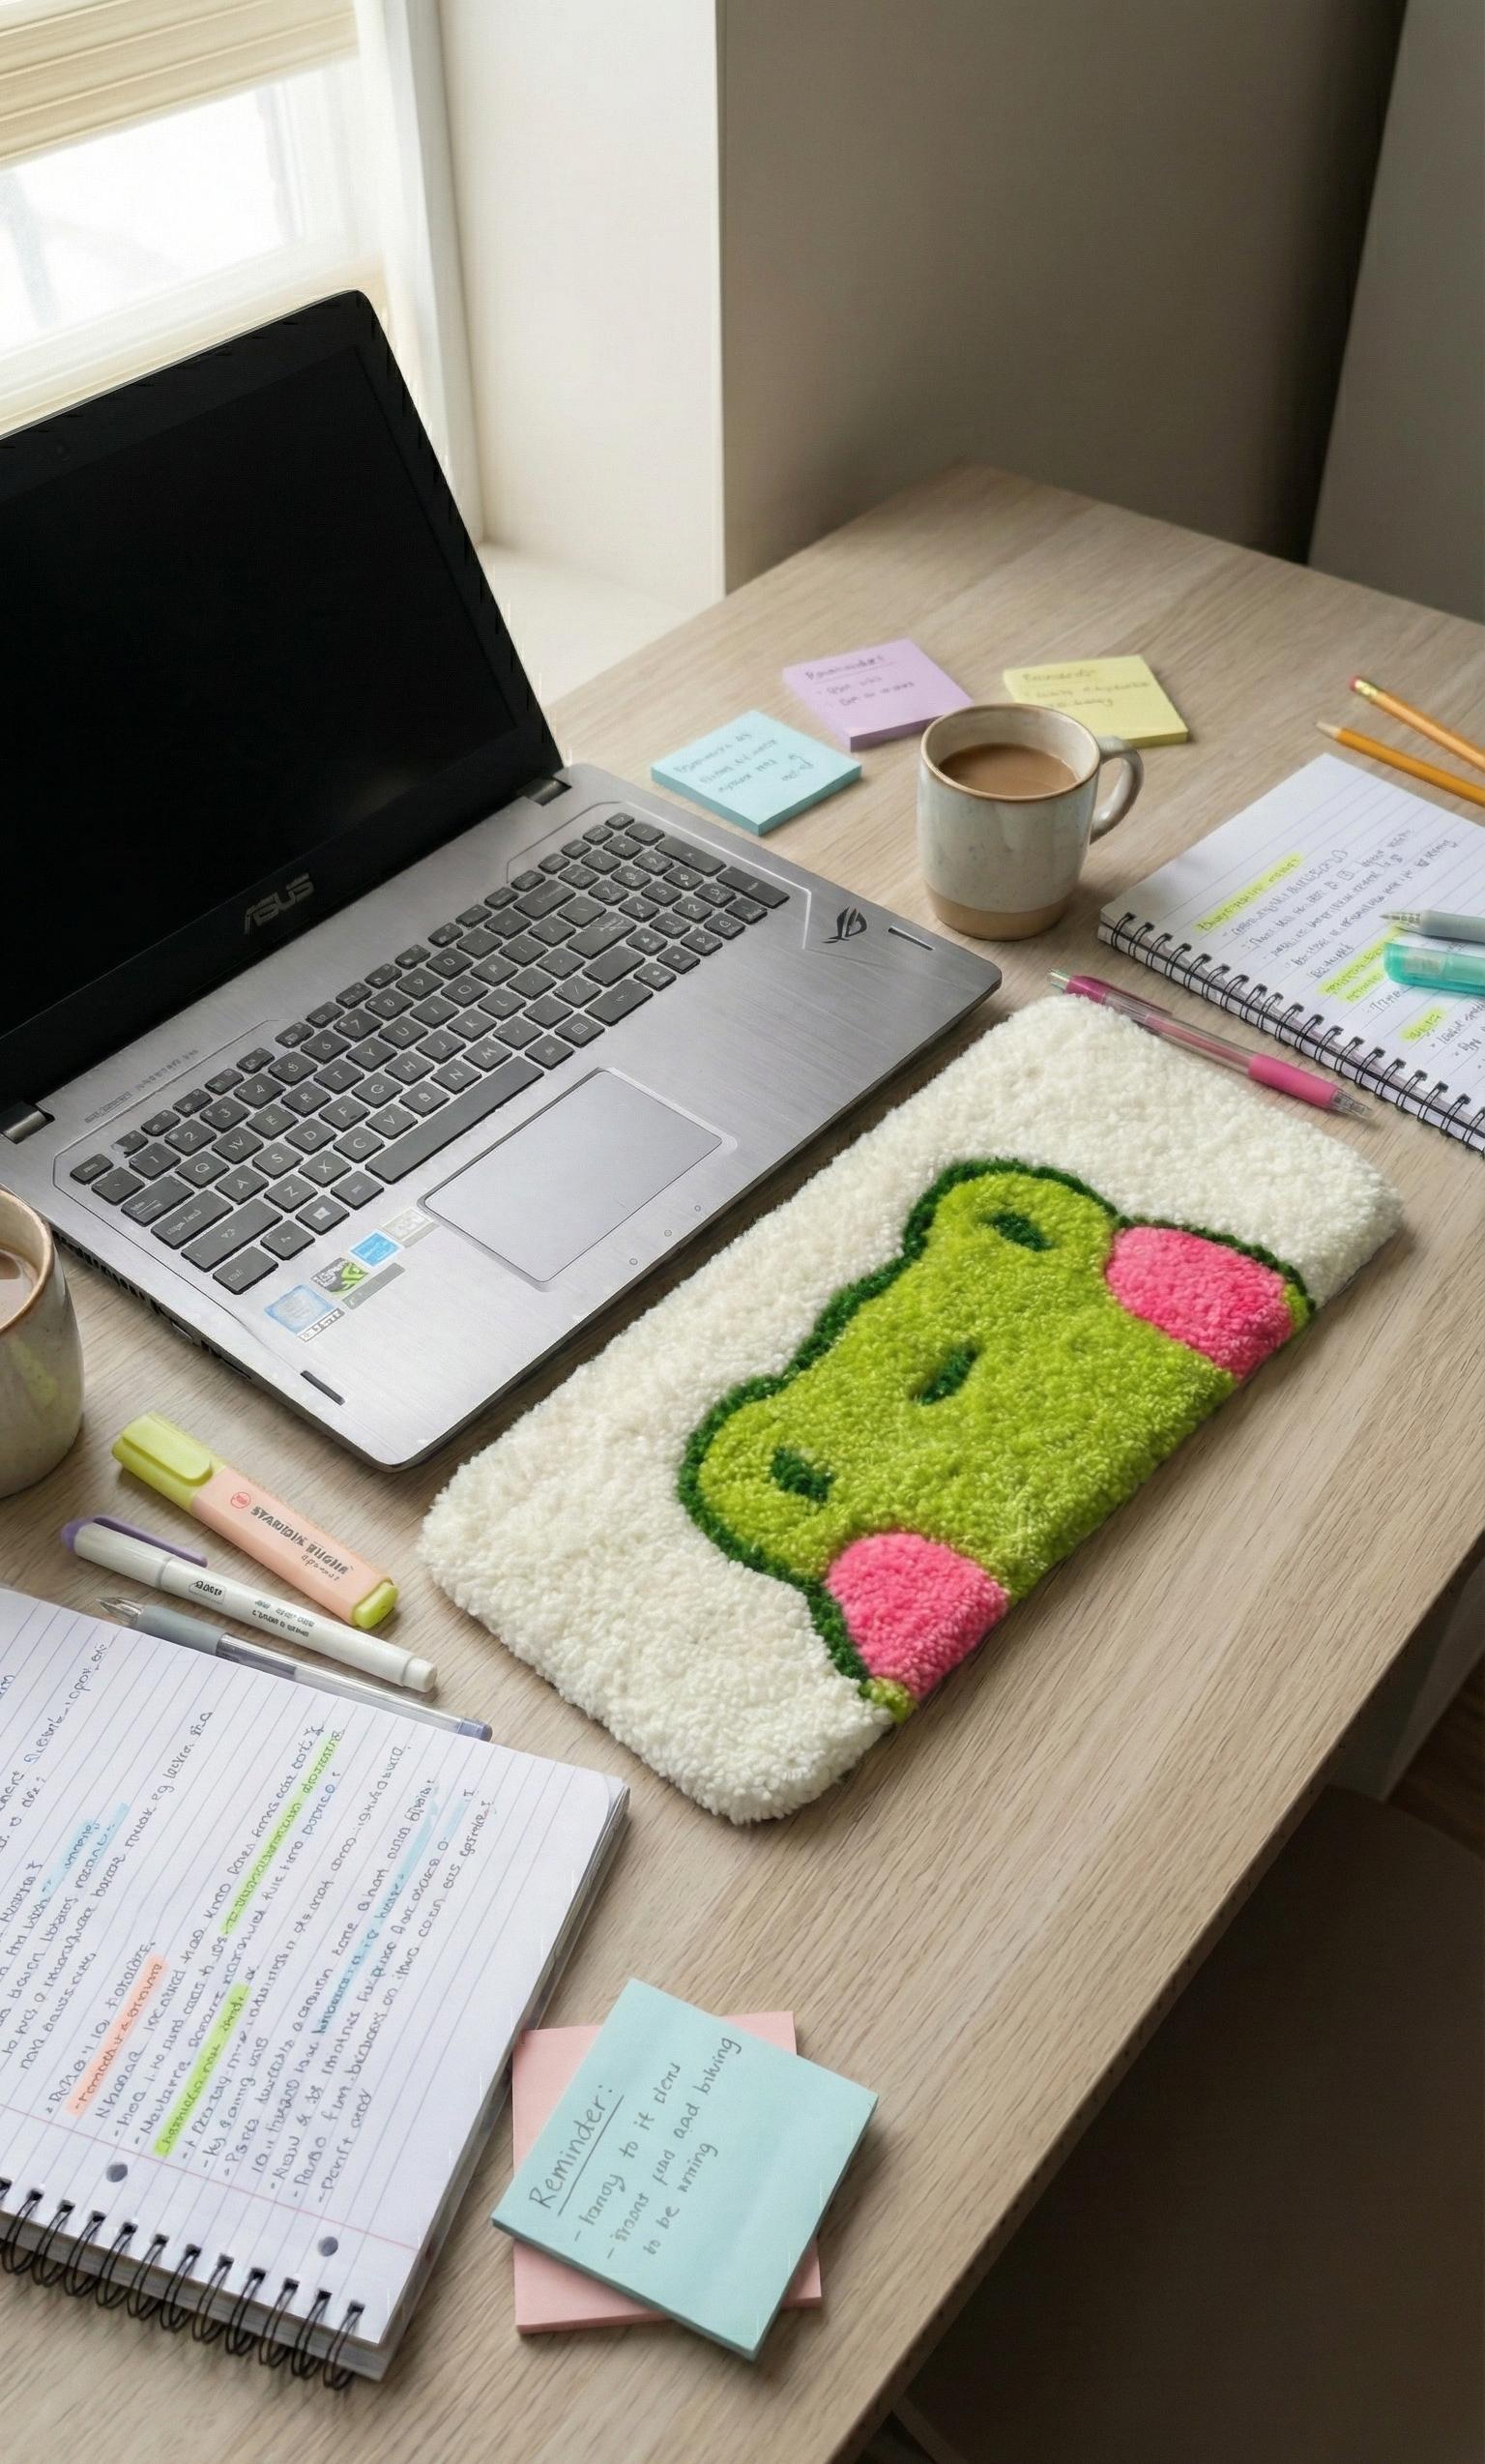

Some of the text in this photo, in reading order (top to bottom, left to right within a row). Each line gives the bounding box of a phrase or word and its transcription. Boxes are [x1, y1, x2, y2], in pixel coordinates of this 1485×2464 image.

[244, 873, 314, 935] ASUS
[529, 2085, 612, 2209] Reminder:
[619, 2141, 639, 2159] to
[633, 2112, 655, 2130] it
[655, 2206, 680, 2230] be
